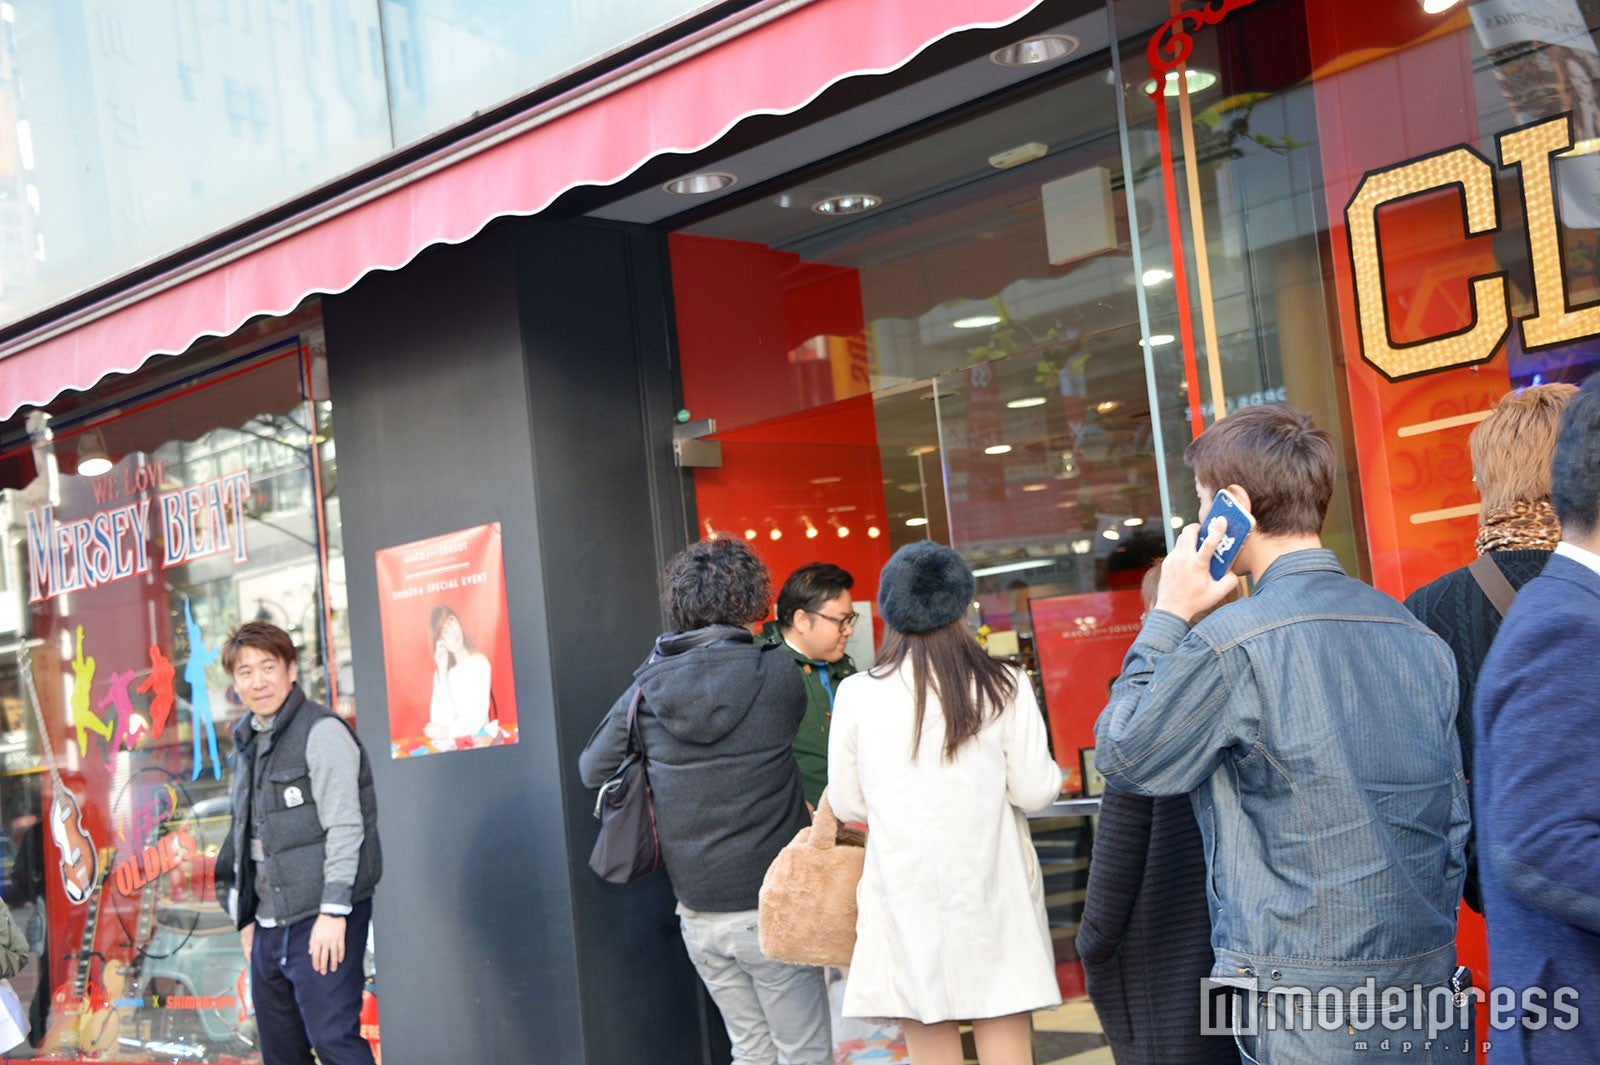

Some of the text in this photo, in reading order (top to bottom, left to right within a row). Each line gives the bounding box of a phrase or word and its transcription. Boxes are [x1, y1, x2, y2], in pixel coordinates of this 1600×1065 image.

[92, 475, 120, 504] WE
[25, 469, 249, 605] MERSEY BEAT
[461, 571, 488, 586] EVENT
